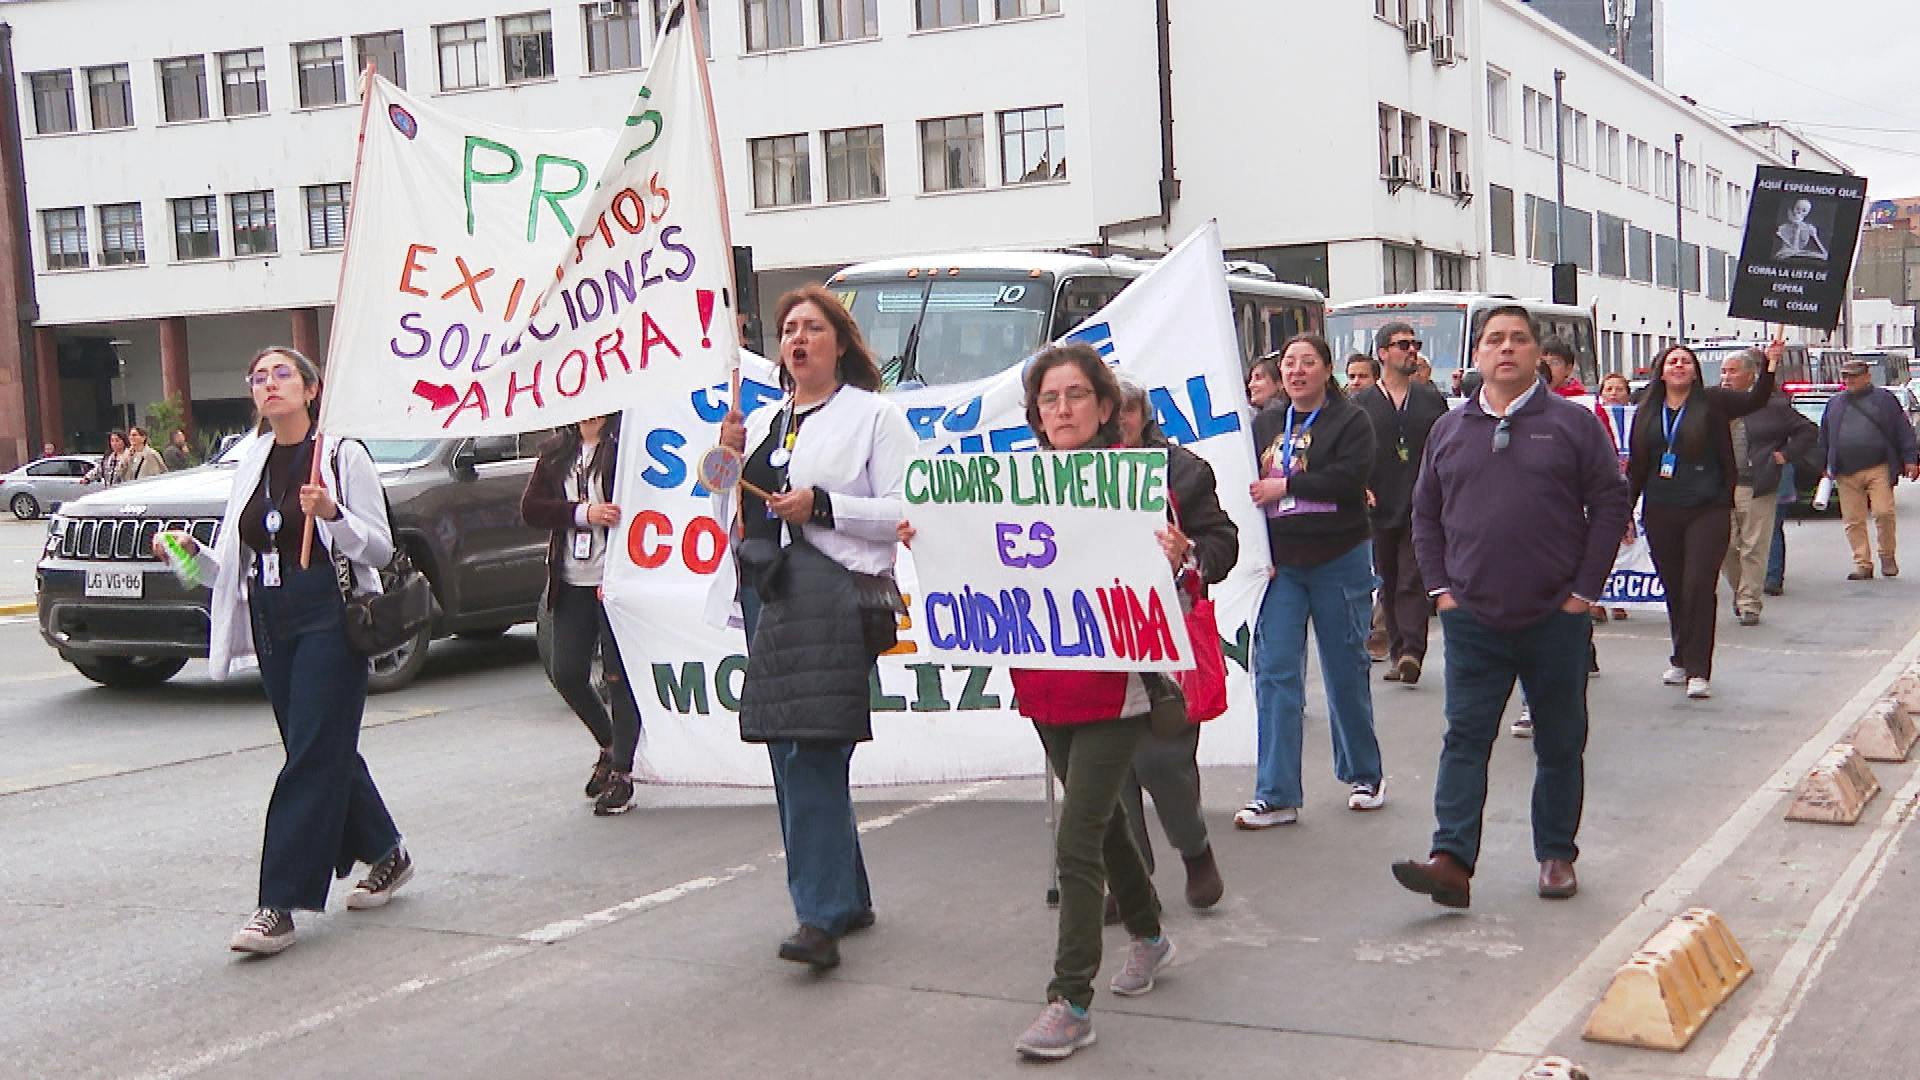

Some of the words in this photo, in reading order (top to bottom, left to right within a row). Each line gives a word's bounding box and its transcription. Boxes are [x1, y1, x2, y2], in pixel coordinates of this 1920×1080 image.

[1783, 182, 1836, 196] ESPERANDO
[1778, 268, 1790, 278] LA
[1790, 269, 1814, 281] LISTA
[1815, 271, 1828, 281] DE
[996, 285, 1026, 304] 10
[1771, 283, 1804, 295] ESPERA
[1762, 298, 1778, 309] DEL
[1785, 301, 1818, 313] COSAM
[904, 455, 1004, 505] CUIDAR
[1009, 454, 1050, 507] LA
[1052, 451, 1167, 513] MENTE
[995, 520, 1058, 569] ES
[925, 583, 1047, 655] CUIDAR
[1043, 587, 1106, 659] LA
[1096, 577, 1181, 662] VIDA
